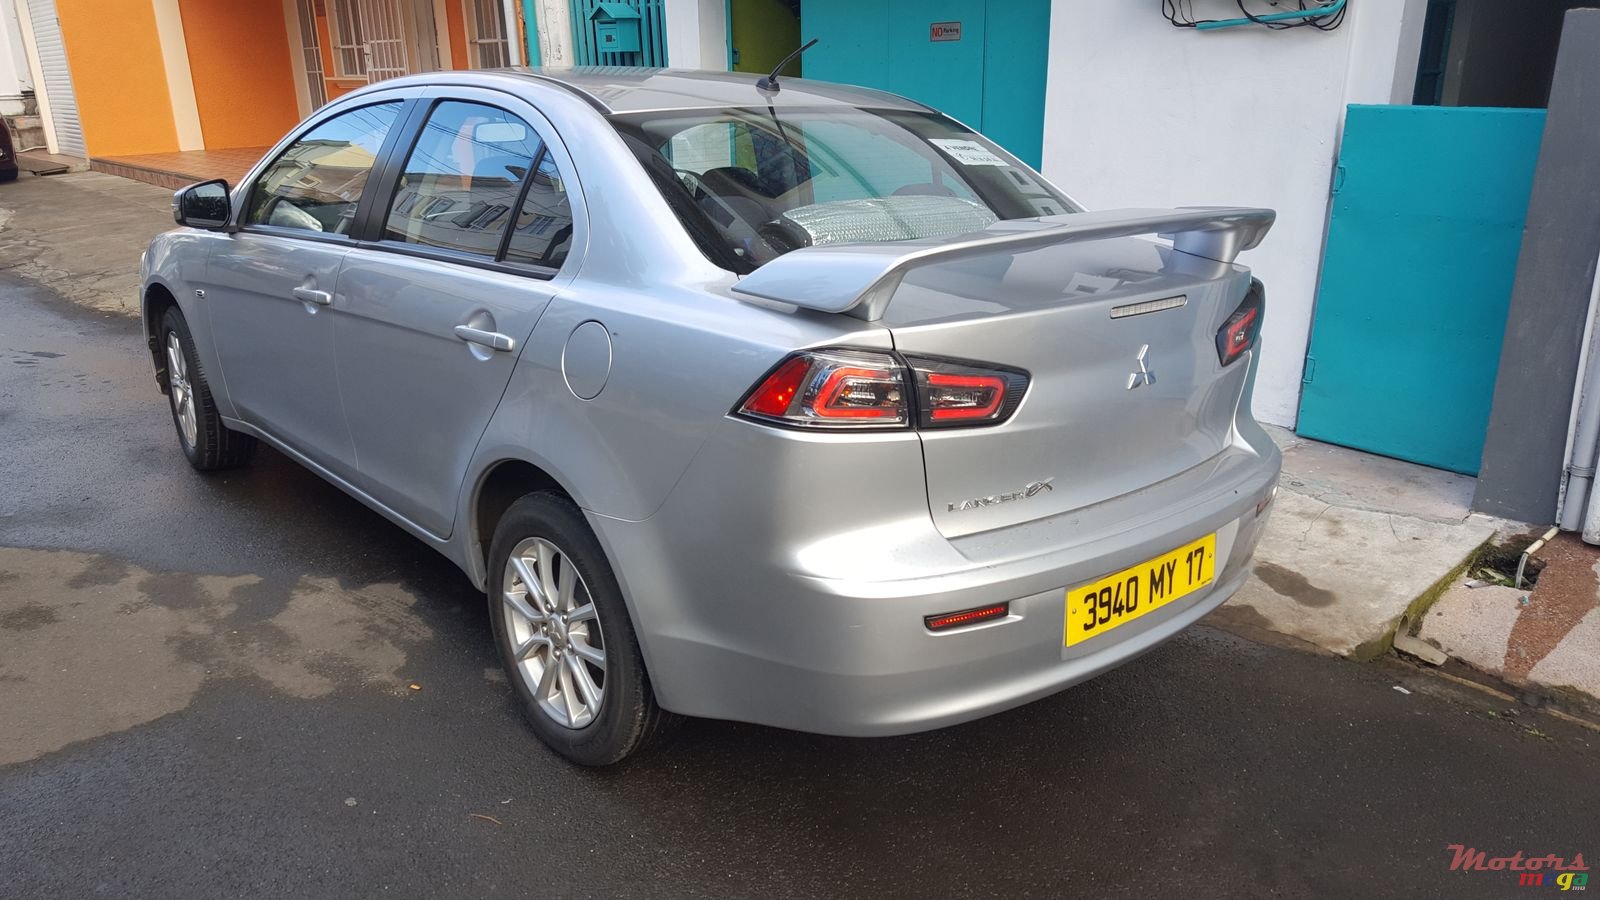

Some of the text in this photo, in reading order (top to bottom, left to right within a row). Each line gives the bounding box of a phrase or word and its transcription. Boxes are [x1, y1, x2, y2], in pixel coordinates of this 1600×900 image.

[932, 27, 943, 37] NO
[947, 492, 1024, 512] LANCER
[1083, 546, 1205, 631] 3940 MY 17
